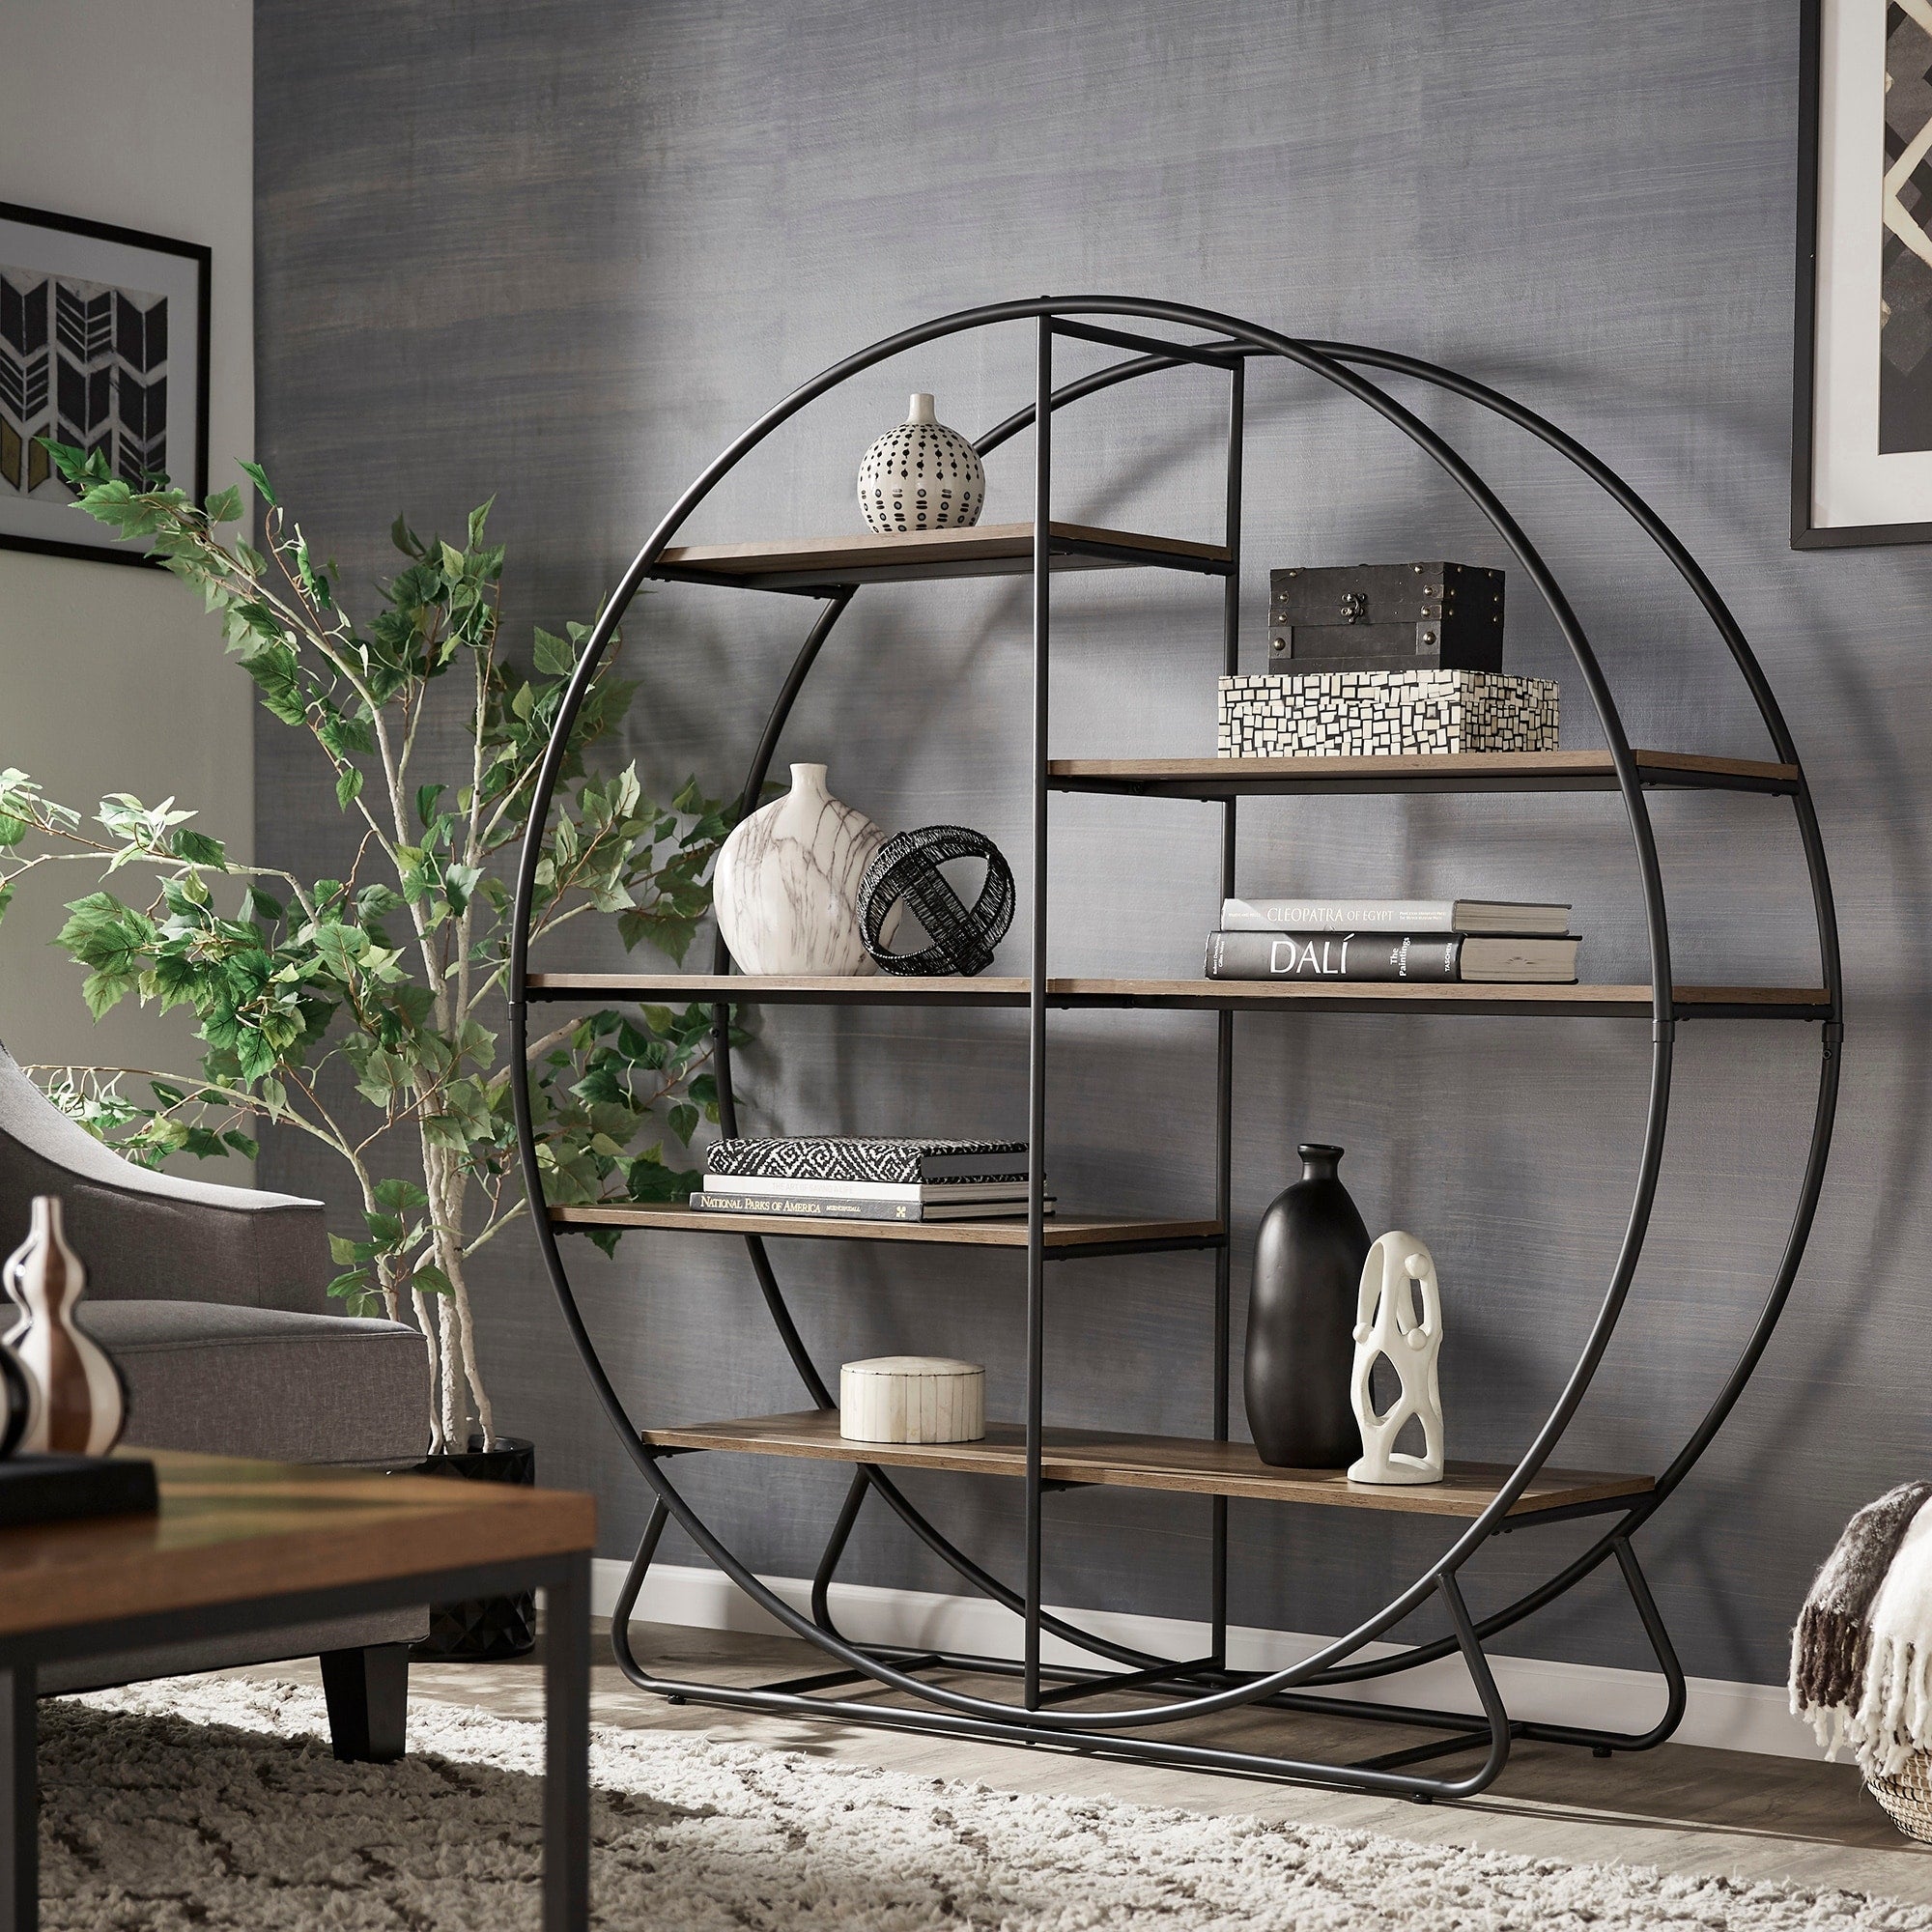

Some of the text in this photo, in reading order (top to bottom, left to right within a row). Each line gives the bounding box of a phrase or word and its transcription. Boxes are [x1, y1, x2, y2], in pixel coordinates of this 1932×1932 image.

[1266, 907, 1344, 923] CLEOPATRA
[1347, 910, 1361, 922] OF
[1362, 910, 1395, 922] EGYPT
[1270, 933, 1355, 975] DALÍ
[1390, 936, 1411, 977] The Paintings
[1444, 942, 1453, 972] TASCHEN
[772, 1181, 785, 1191] THE
[700, 1195, 743, 1208] NATIONAL
[744, 1198, 771, 1210] PARKS
[771, 1201, 783, 1211] OF
[782, 1200, 821, 1213] AMERICA
